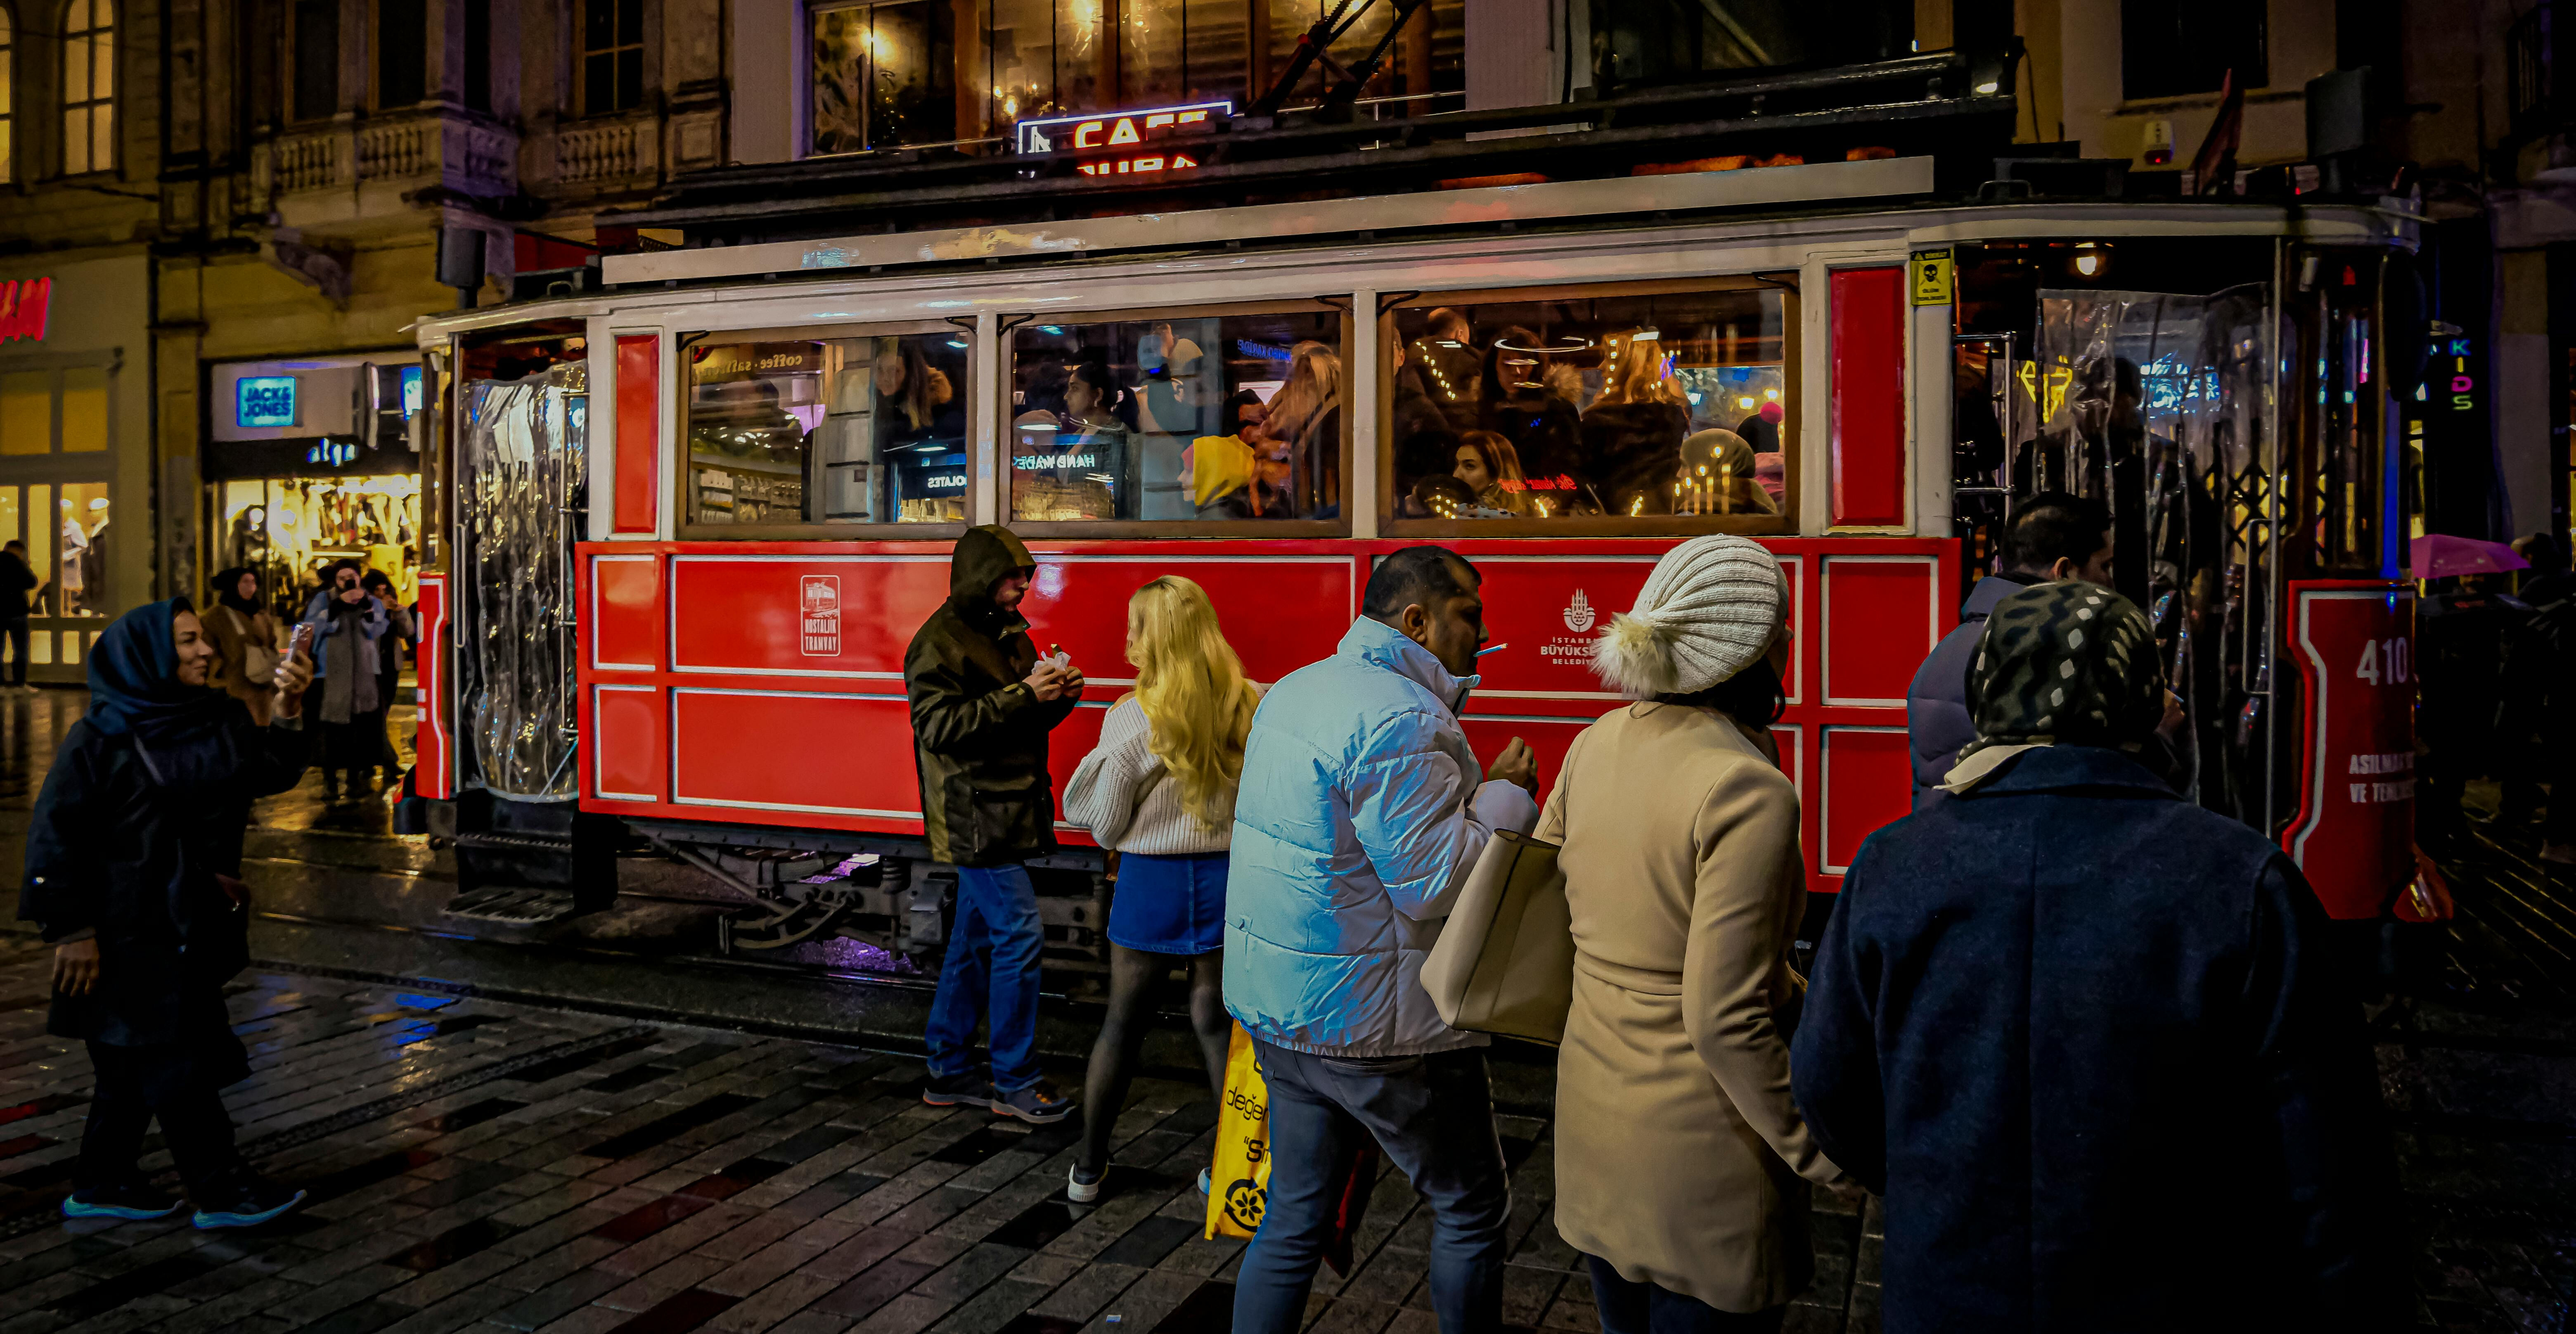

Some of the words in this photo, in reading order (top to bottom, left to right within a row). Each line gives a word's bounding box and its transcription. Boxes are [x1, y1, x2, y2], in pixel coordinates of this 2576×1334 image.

[2449, 339, 2473, 411] KIDS
[244, 402, 291, 417] JONES
[805, 636, 836, 651] TRAMVAY
[2356, 637, 2408, 686] 410
